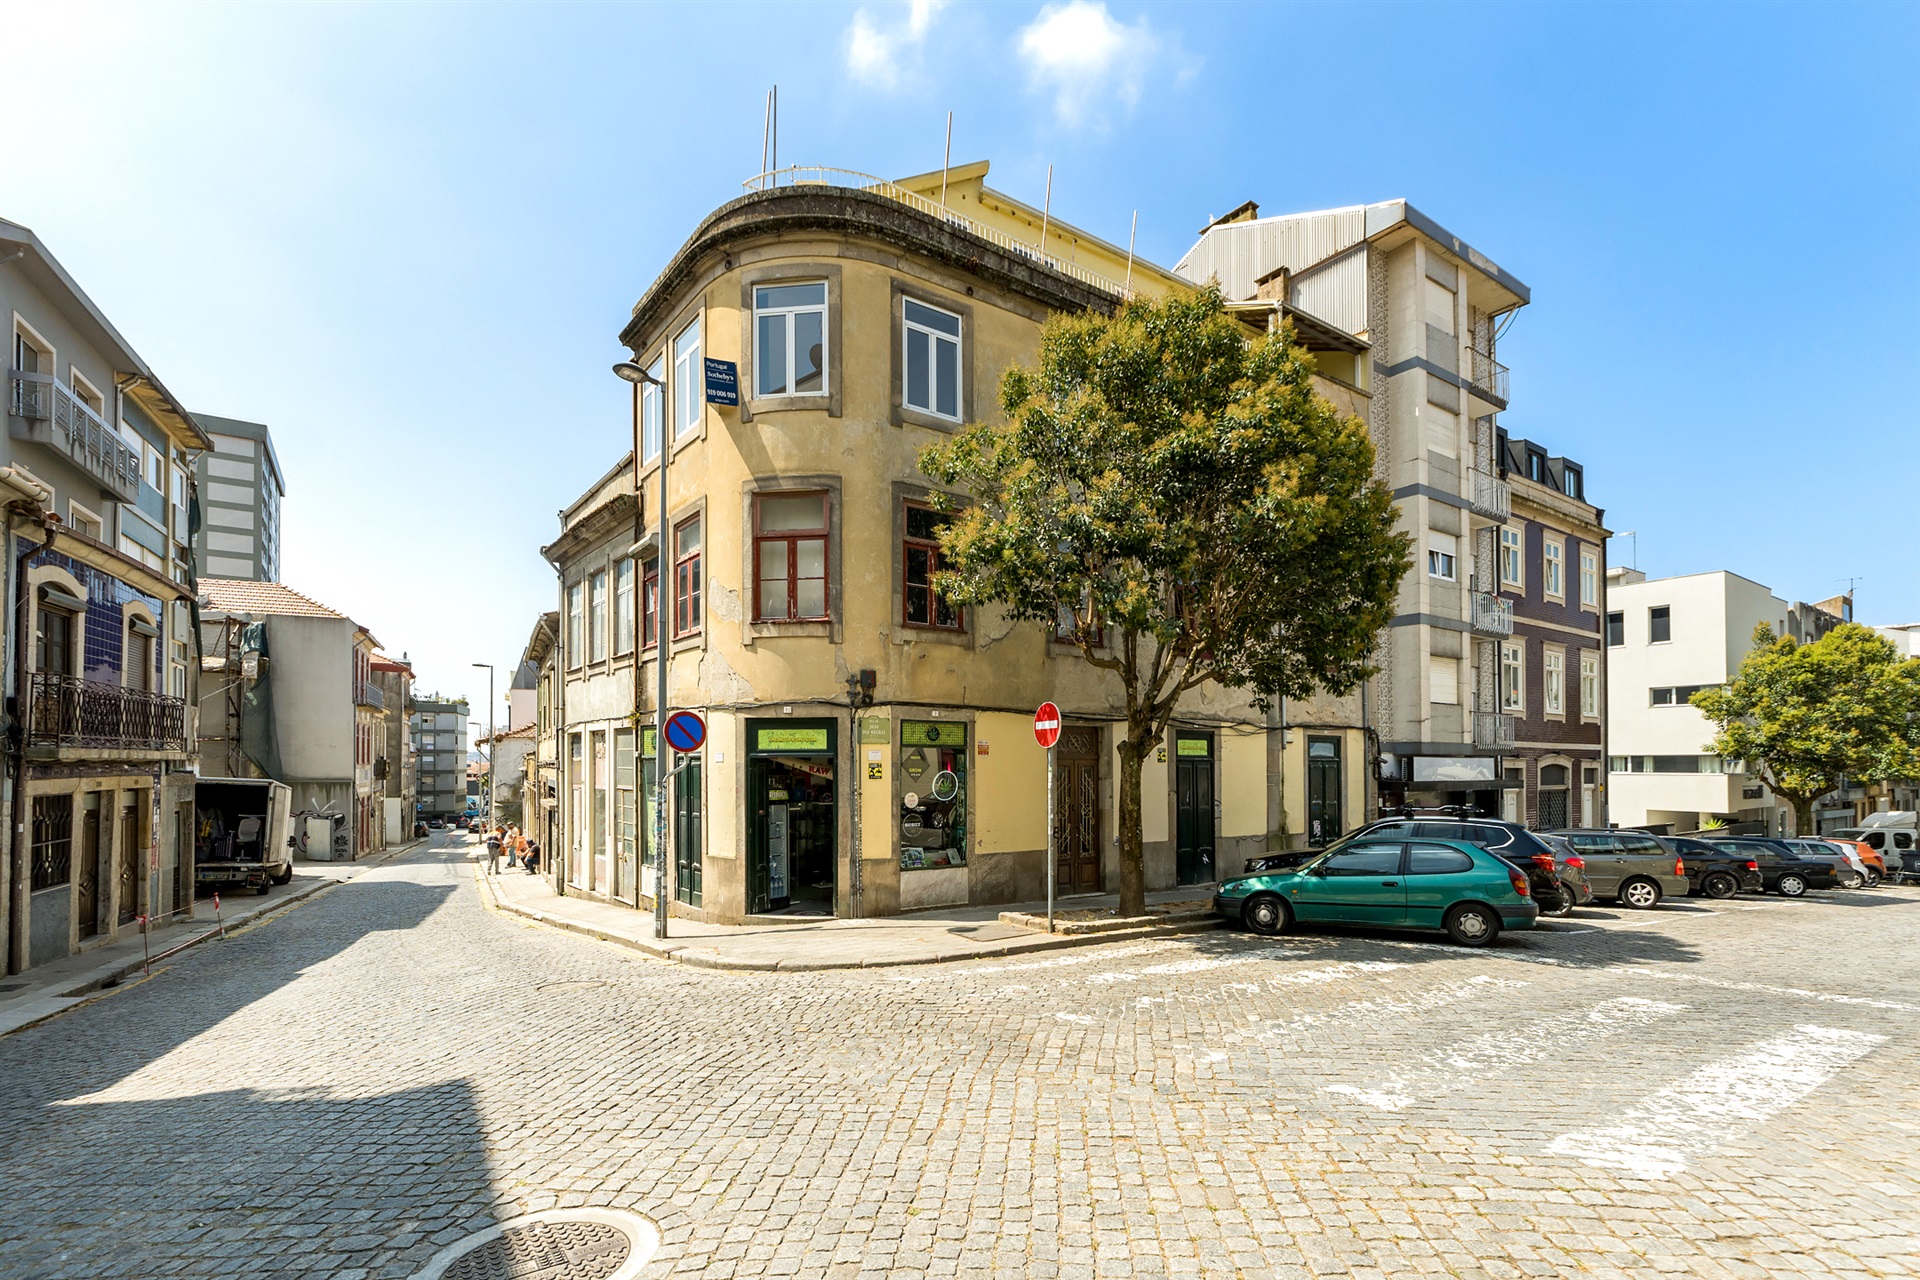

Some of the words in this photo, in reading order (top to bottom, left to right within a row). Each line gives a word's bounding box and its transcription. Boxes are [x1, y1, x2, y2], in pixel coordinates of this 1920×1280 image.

[706, 361, 728, 370] Portugal
[707, 371, 734, 381] Sotheby's
[808, 765, 831, 775] RAW
